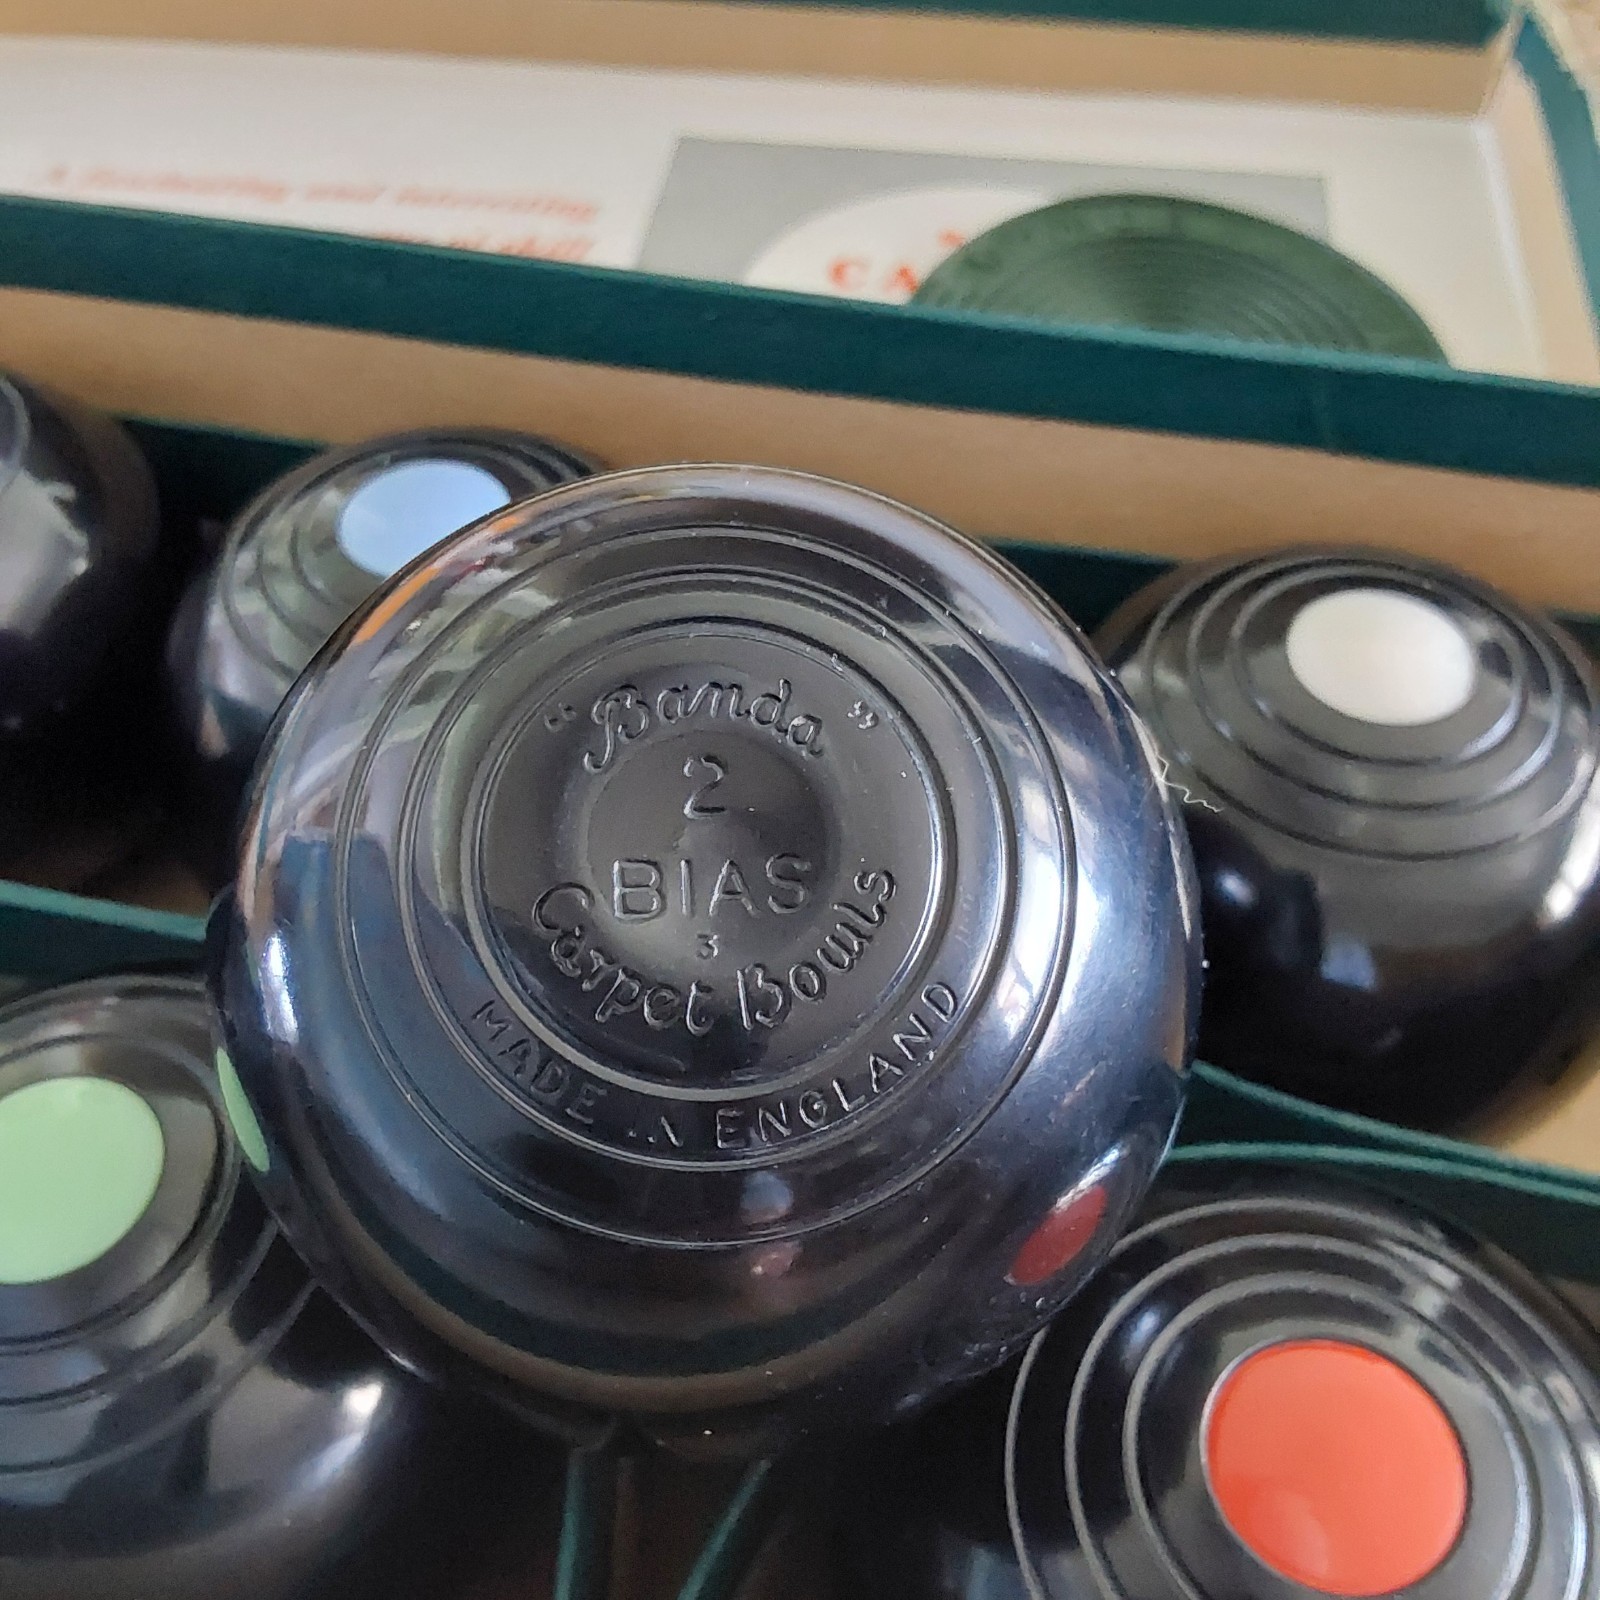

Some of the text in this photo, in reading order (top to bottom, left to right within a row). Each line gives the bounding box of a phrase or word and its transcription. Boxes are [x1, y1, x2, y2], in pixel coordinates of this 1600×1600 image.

[682, 754, 728, 820] 2
[612, 853, 812, 924] BIAS
[532, 868, 898, 1037] Carpet Bowls
[696, 933, 720, 961] 3
[472, 999, 608, 1125] MADE
[715, 981, 960, 1150] ENGLAND
